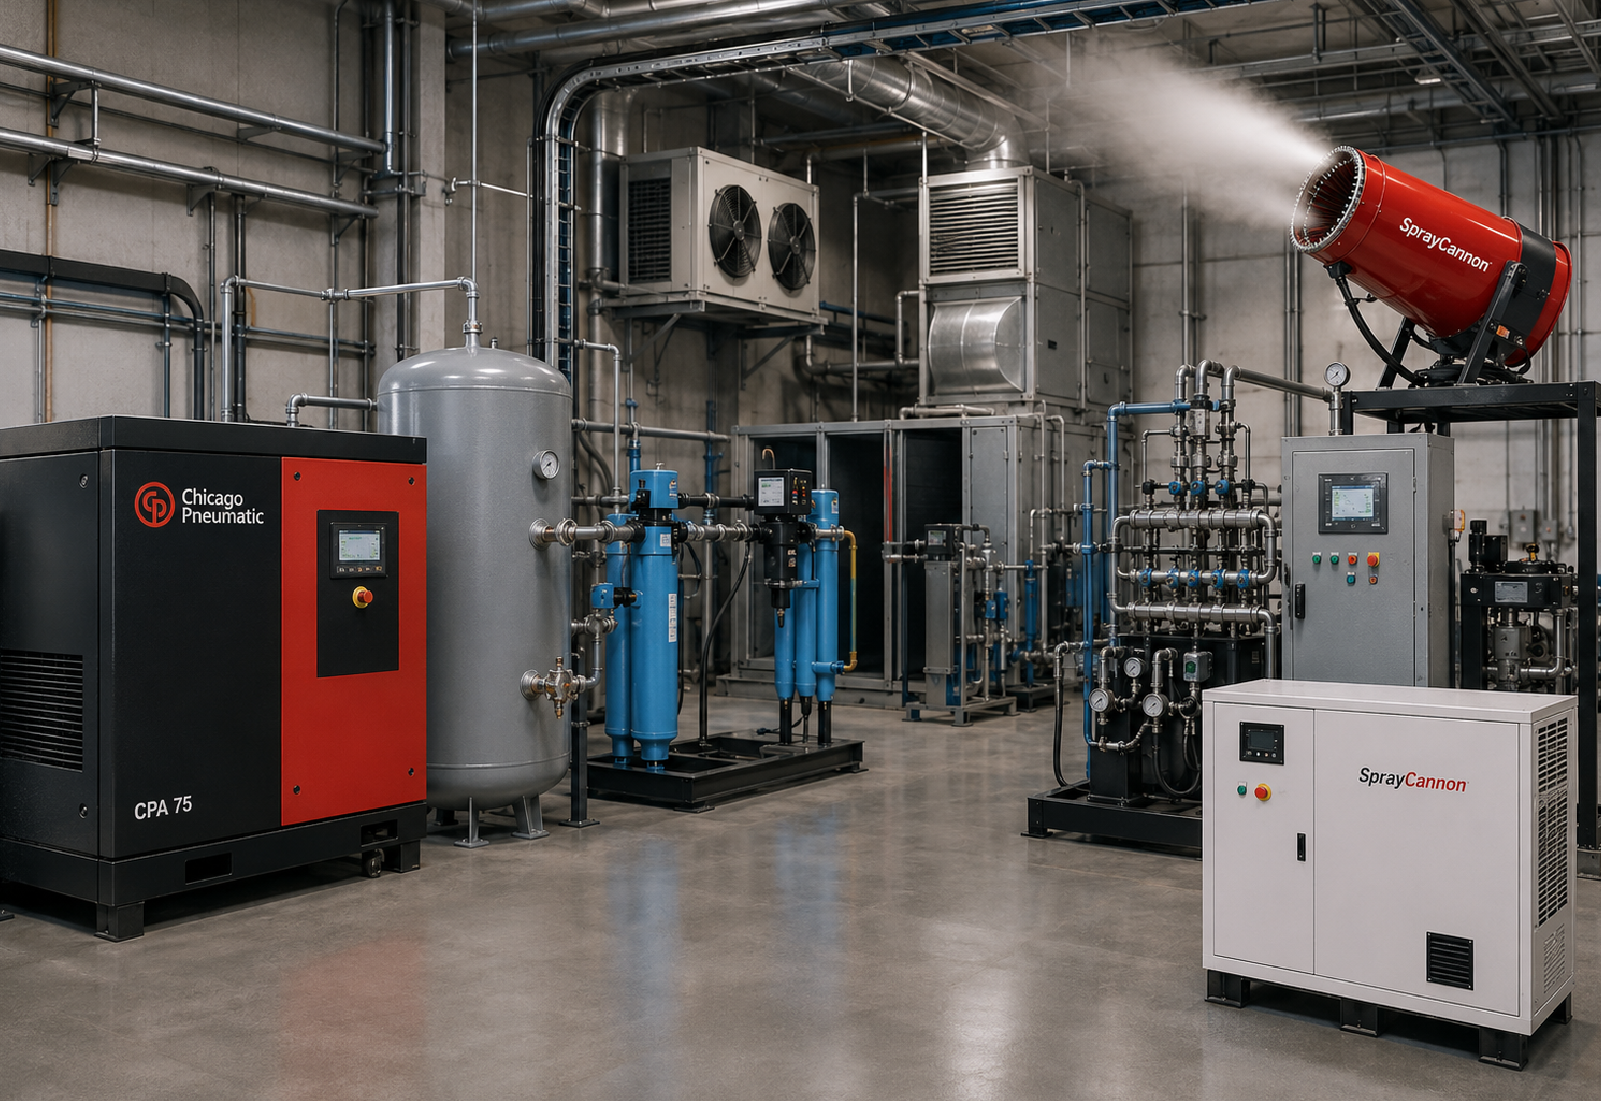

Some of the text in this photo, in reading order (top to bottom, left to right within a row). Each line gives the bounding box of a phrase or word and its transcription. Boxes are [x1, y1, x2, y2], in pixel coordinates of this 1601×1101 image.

[1399, 217, 1489, 272] SprayCannon
[182, 487, 244, 509] Chicago
[182, 506, 265, 525] Pneumatic
[1359, 767, 1468, 792] SprayCannon
[134, 795, 193, 820] CPA 75
